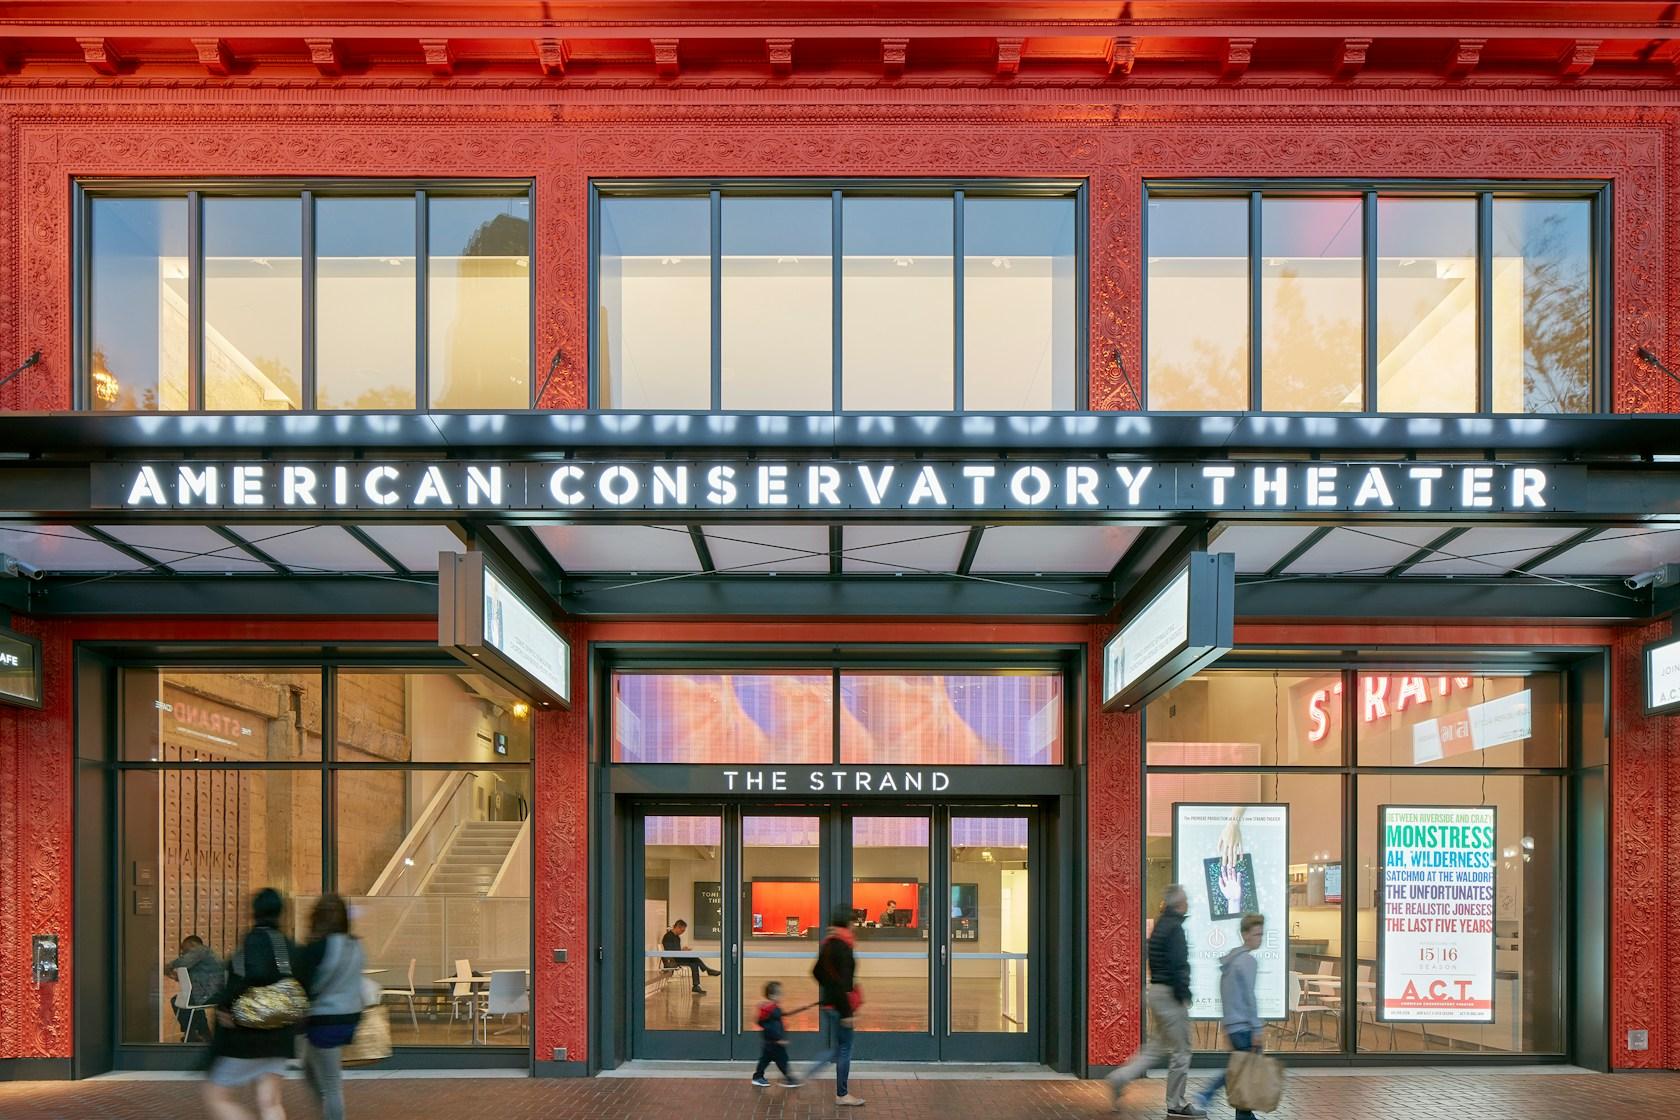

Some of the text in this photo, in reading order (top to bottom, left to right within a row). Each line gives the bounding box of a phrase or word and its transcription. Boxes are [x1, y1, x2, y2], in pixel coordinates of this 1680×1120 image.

[127, 465, 1547, 507] AMERICAN CONSERVATORY THEATER
[723, 771, 950, 791] THE STRAND
[1386, 825, 1493, 849] MONSTRESS
[1387, 850, 1407, 869] AH,
[1386, 870, 1425, 882] SATCHMO
[1427, 871, 1437, 882] AT
[1439, 871, 1454, 883] THE
[1386, 885, 1492, 901] THE UNFORTUNATES
[1386, 902, 1492, 916] THE REALISTIC JONESES
[1386, 918, 1492, 933] THE LAST FIVE YEARS
[1401, 979, 1475, 1000] A.C.T.
